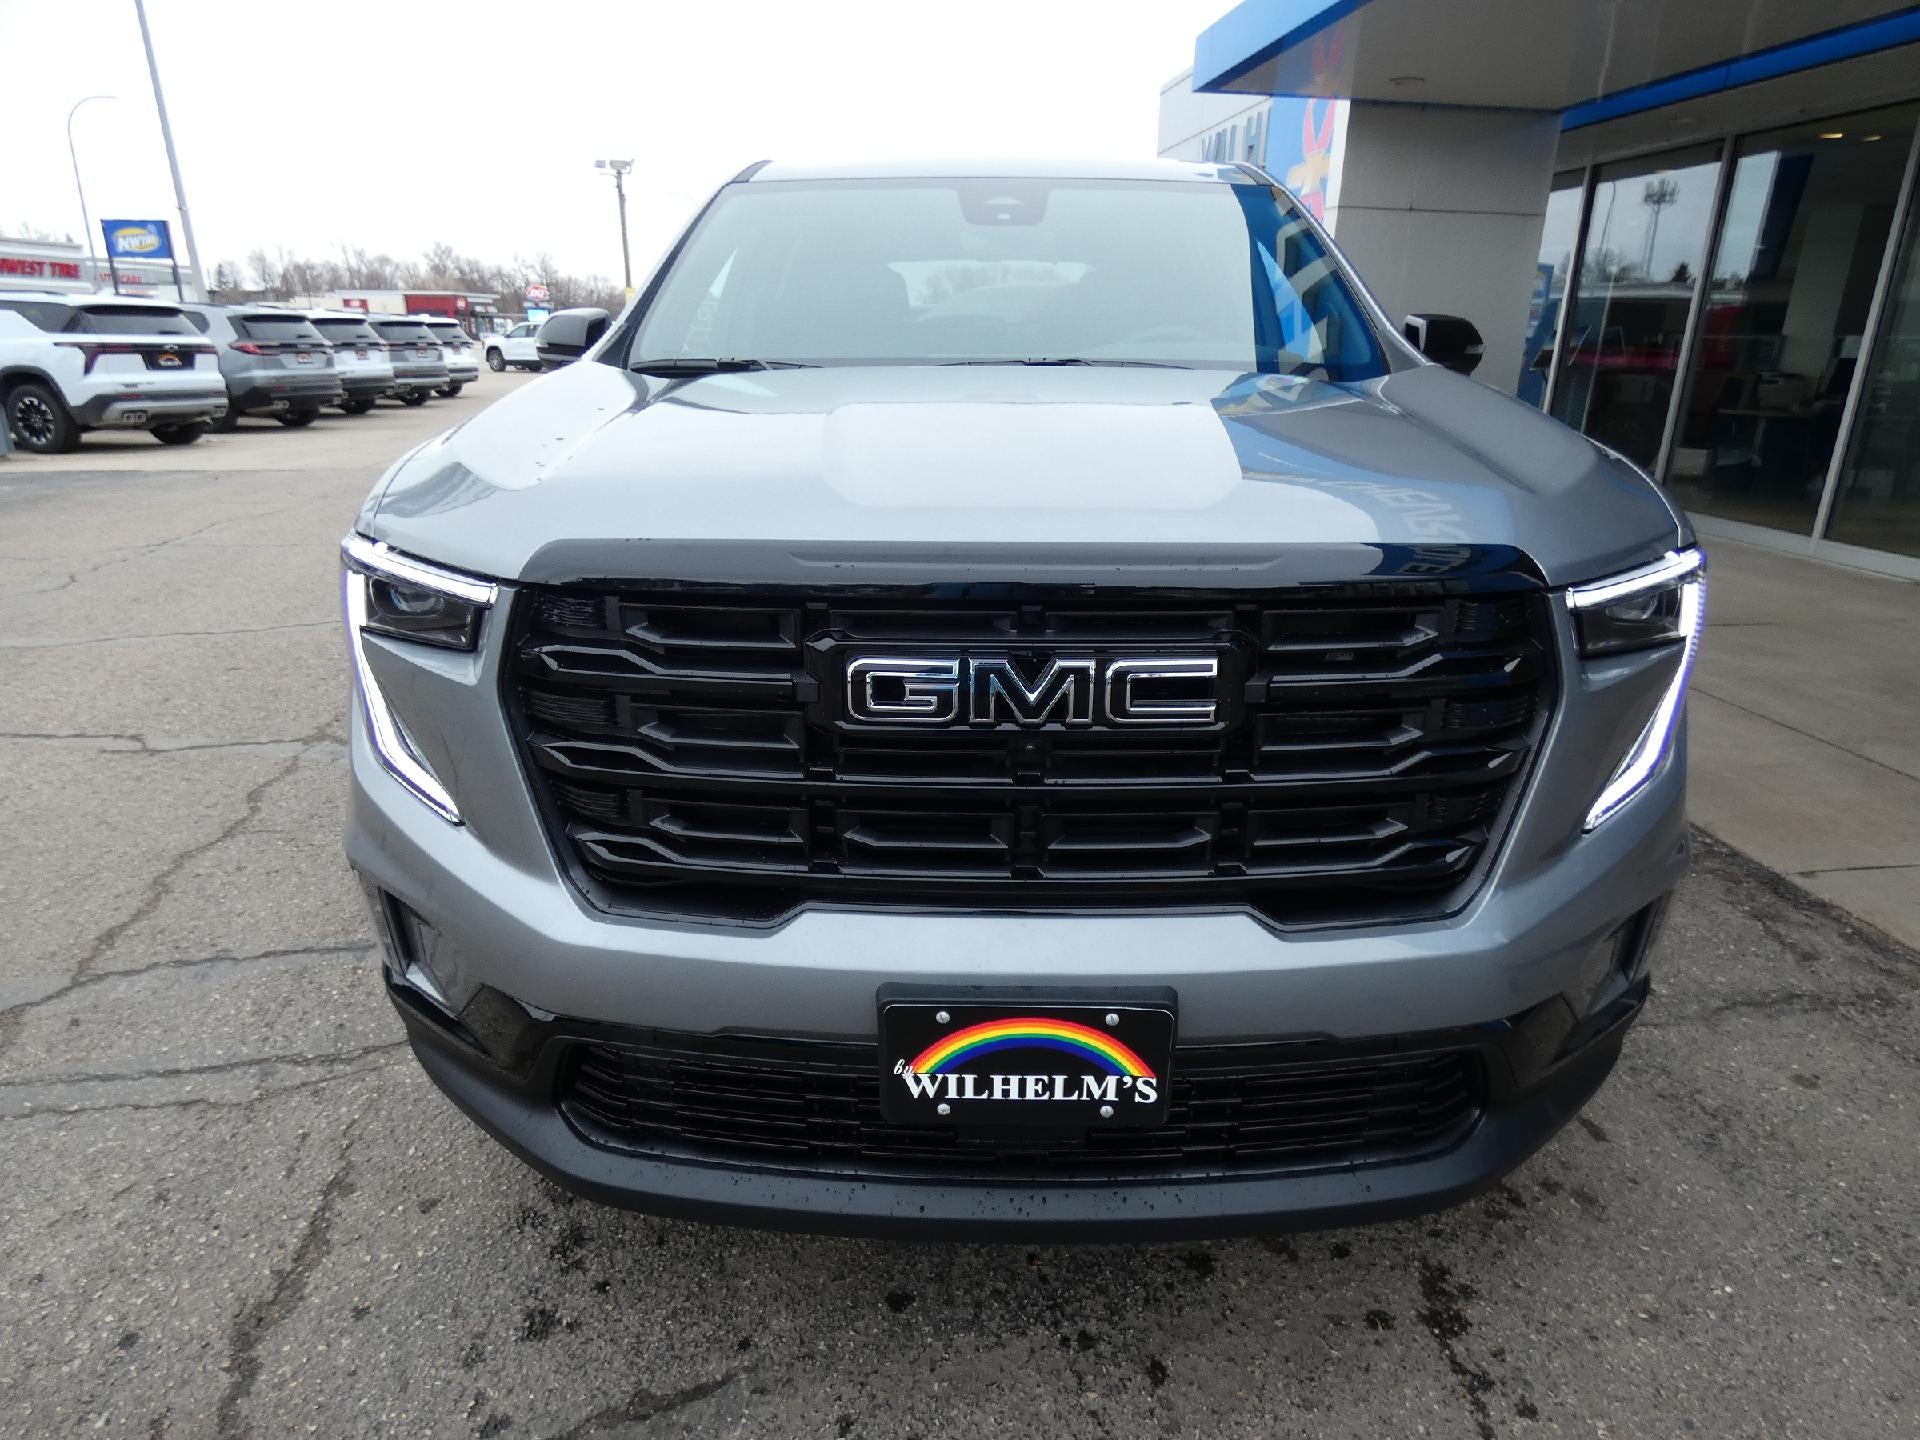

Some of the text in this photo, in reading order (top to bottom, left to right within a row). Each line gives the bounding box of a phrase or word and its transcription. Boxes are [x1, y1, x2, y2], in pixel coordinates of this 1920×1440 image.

[847, 656, 1218, 723] GMC
[893, 1059, 916, 1079] by
[902, 1072, 1159, 1104] WILHELM'S
